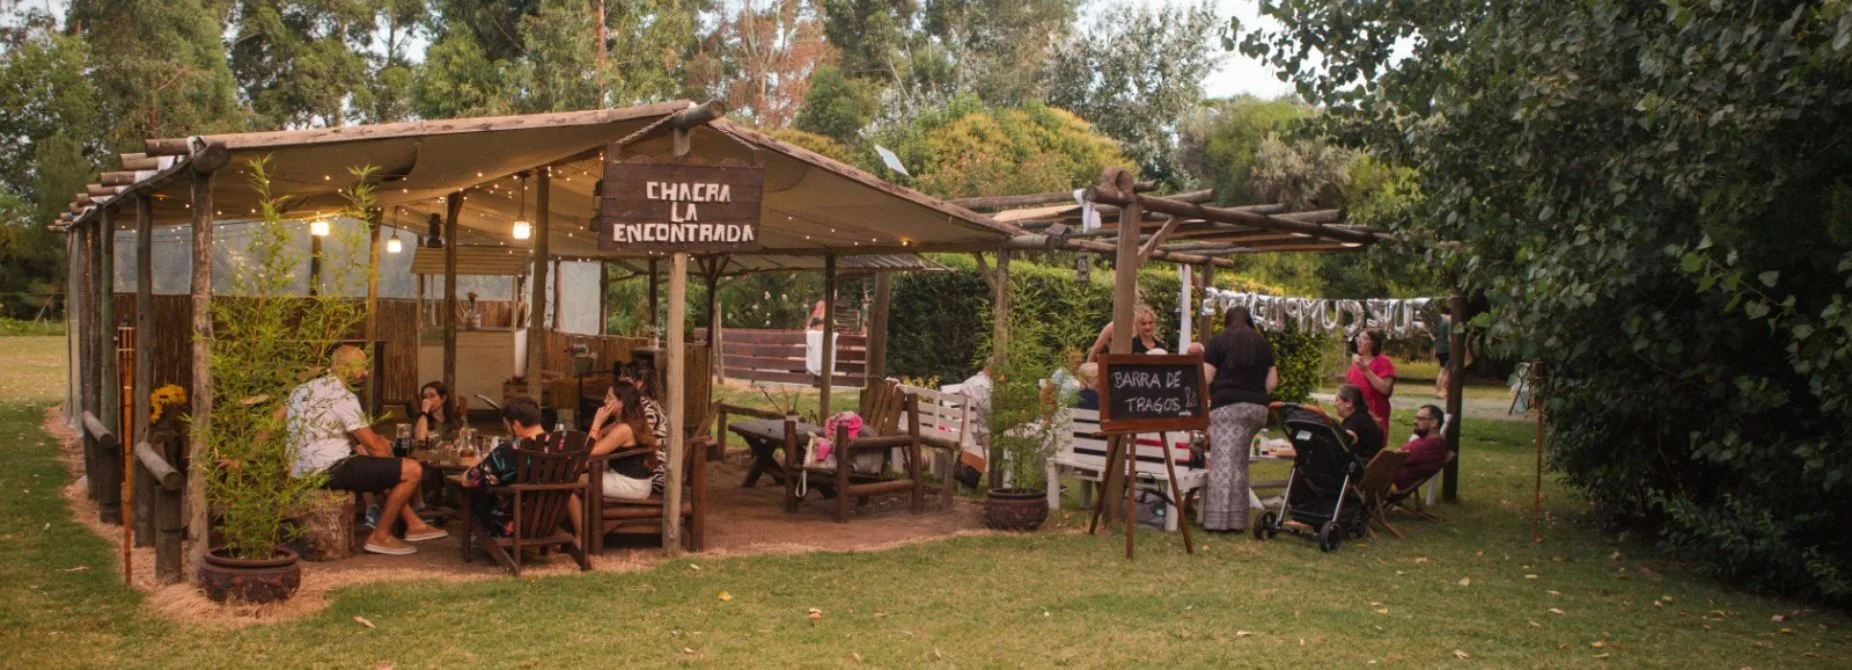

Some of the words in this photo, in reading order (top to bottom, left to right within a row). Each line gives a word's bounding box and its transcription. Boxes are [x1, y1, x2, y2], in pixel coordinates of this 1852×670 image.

[646, 181, 731, 202] CHACRA
[671, 202, 698, 222] LA
[613, 223, 754, 243] ENCONTRADA
[1113, 371, 1162, 389] BARRA
[1166, 370, 1182, 388] DE
[1125, 397, 1181, 413] TRAGOS
